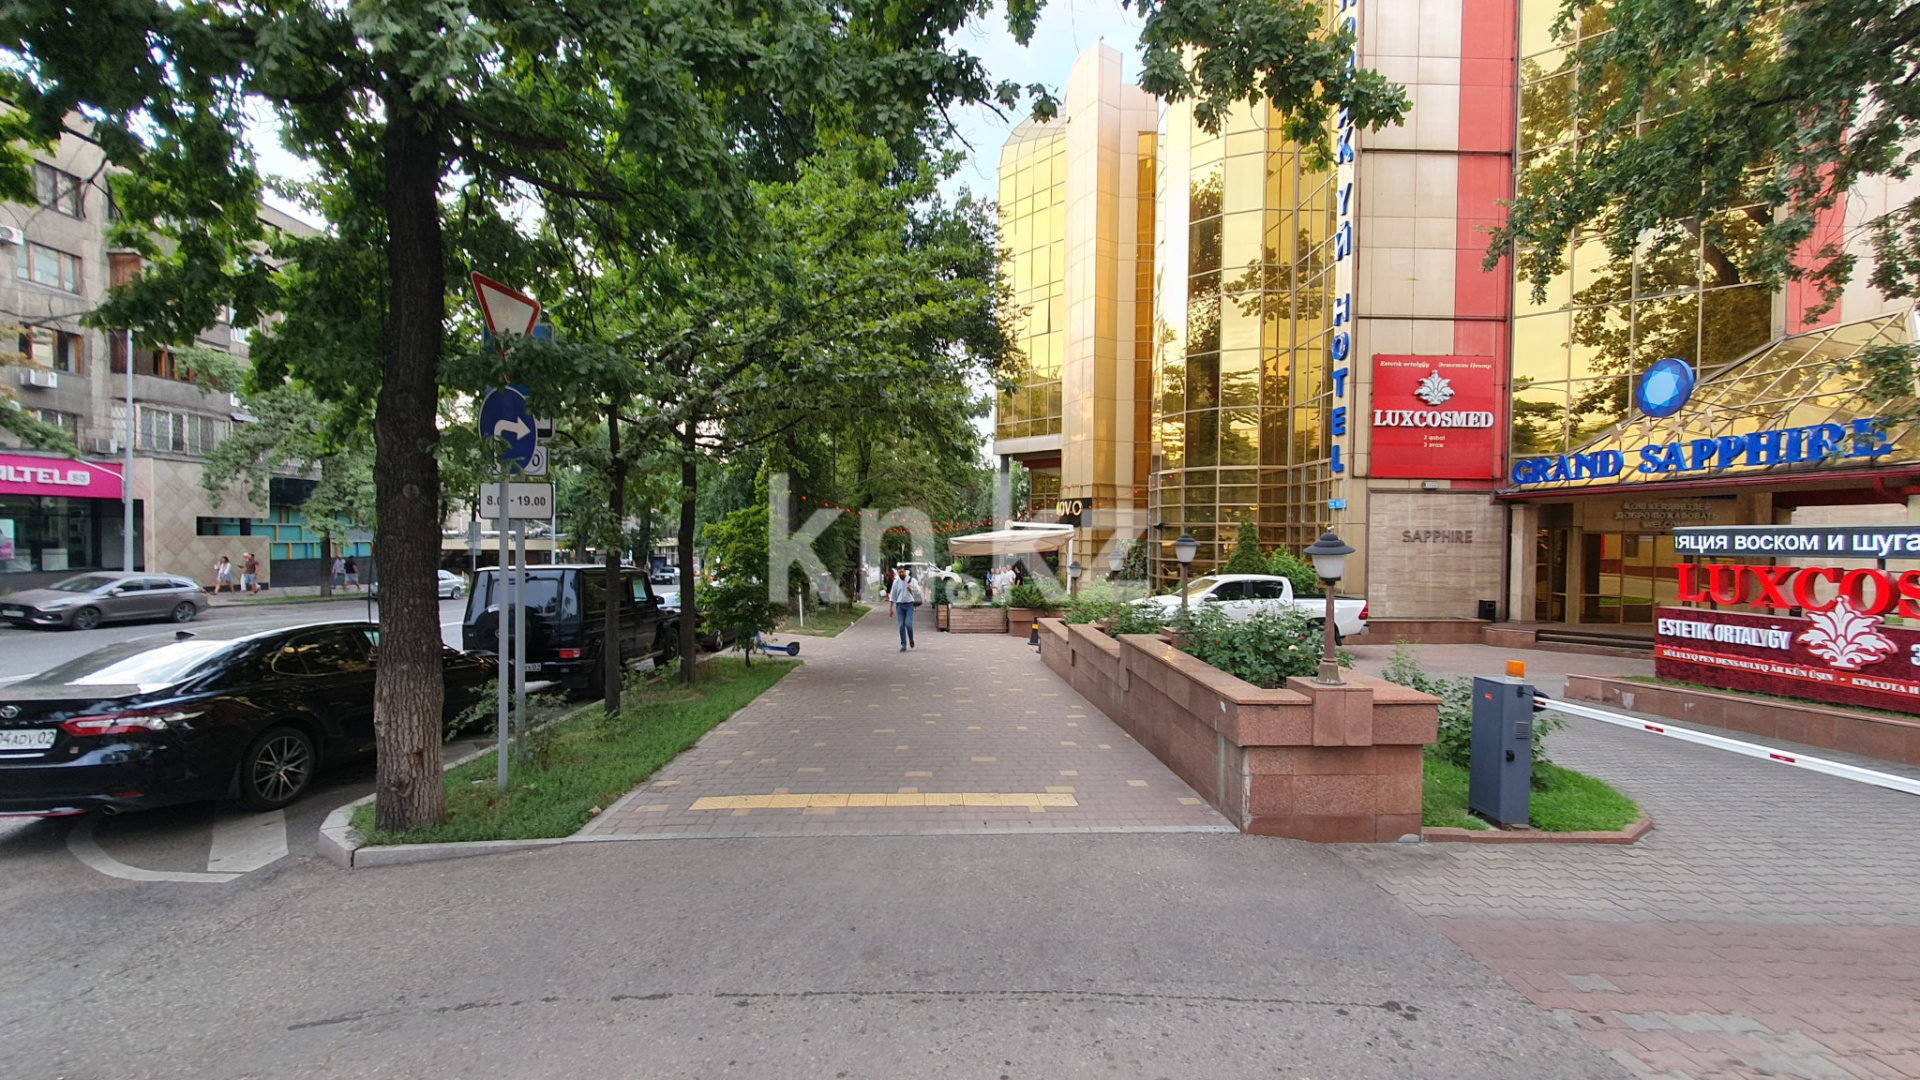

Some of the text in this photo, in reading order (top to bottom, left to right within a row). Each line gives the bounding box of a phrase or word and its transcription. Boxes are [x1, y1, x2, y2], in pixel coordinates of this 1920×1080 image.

[1331, 293, 1350, 474] HOTEL
[1373, 409, 1494, 428] LUXCOSMED
[1512, 417, 1893, 485] GRAND SAPPHIRE
[517, 496, 546, 506] 19.00
[1615, 511, 1650, 520] ДОБРО
[1642, 521, 1690, 529] WELCOM
[1402, 530, 1473, 544] SAPPHIRE
[1658, 618, 1714, 640] ESTETIK
[1852, 677, 1907, 693] КРАСОТА
[37, 731, 55, 744] 02
